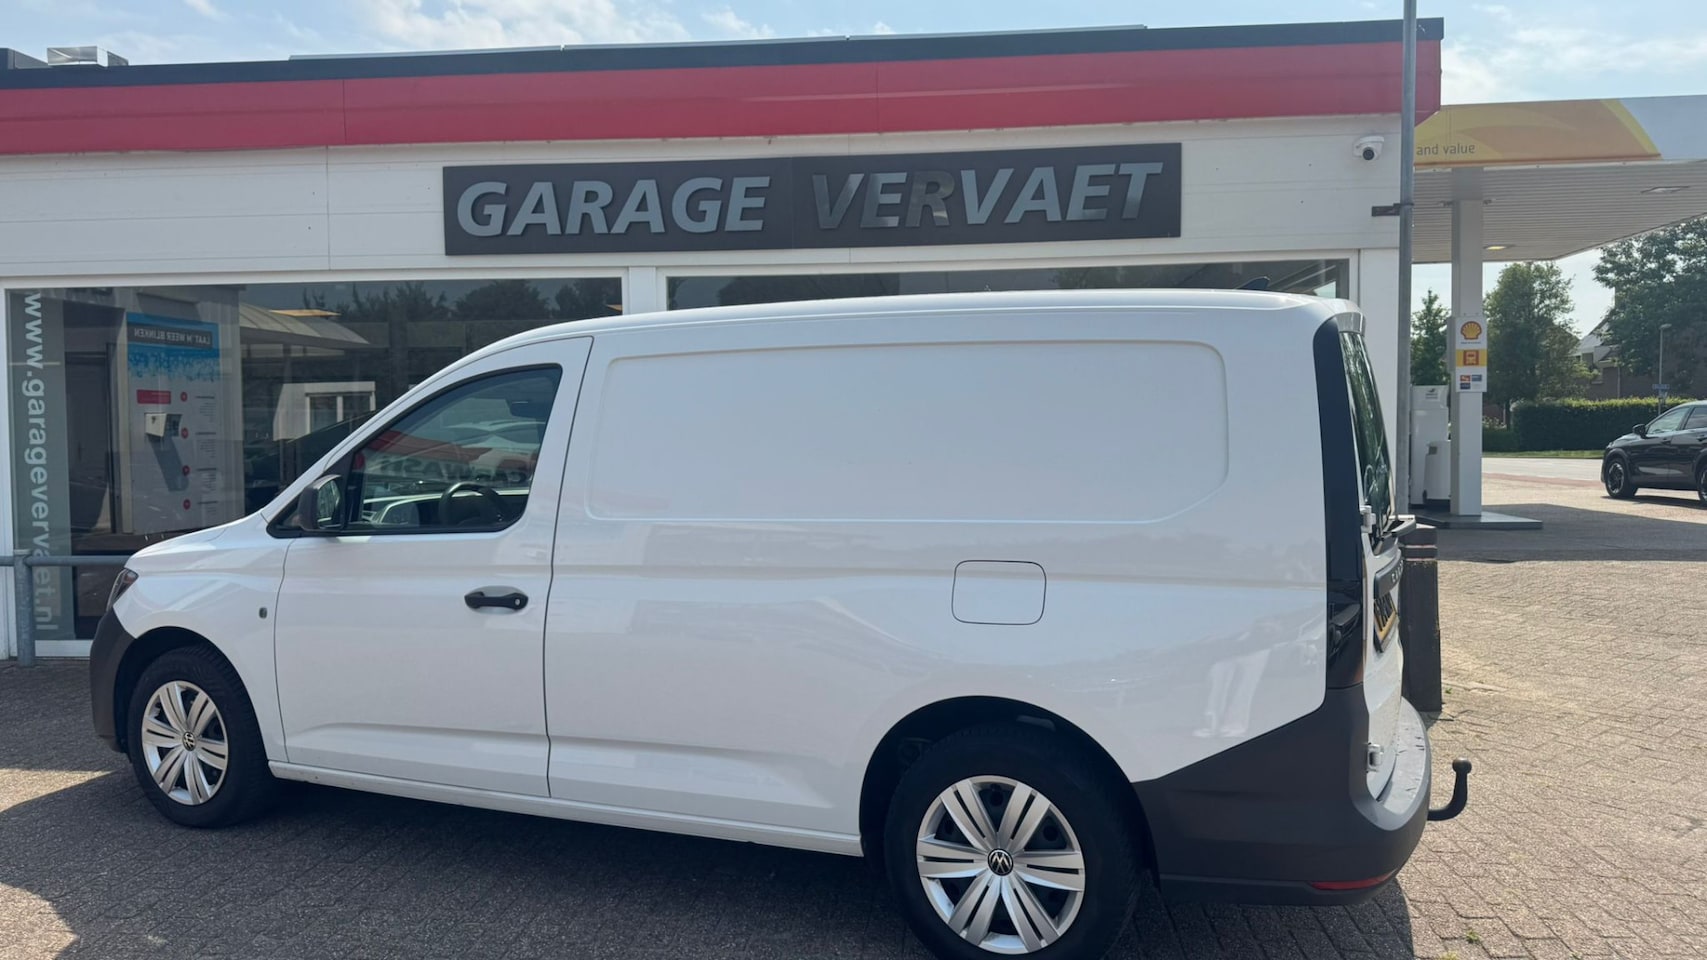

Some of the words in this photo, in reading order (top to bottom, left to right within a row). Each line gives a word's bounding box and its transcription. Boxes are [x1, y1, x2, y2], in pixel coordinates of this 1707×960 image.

[1416, 144, 1439, 156] and
[1443, 142, 1476, 155] value
[457, 176, 770, 237] GARAGE
[812, 162, 1164, 230] VERVAET
